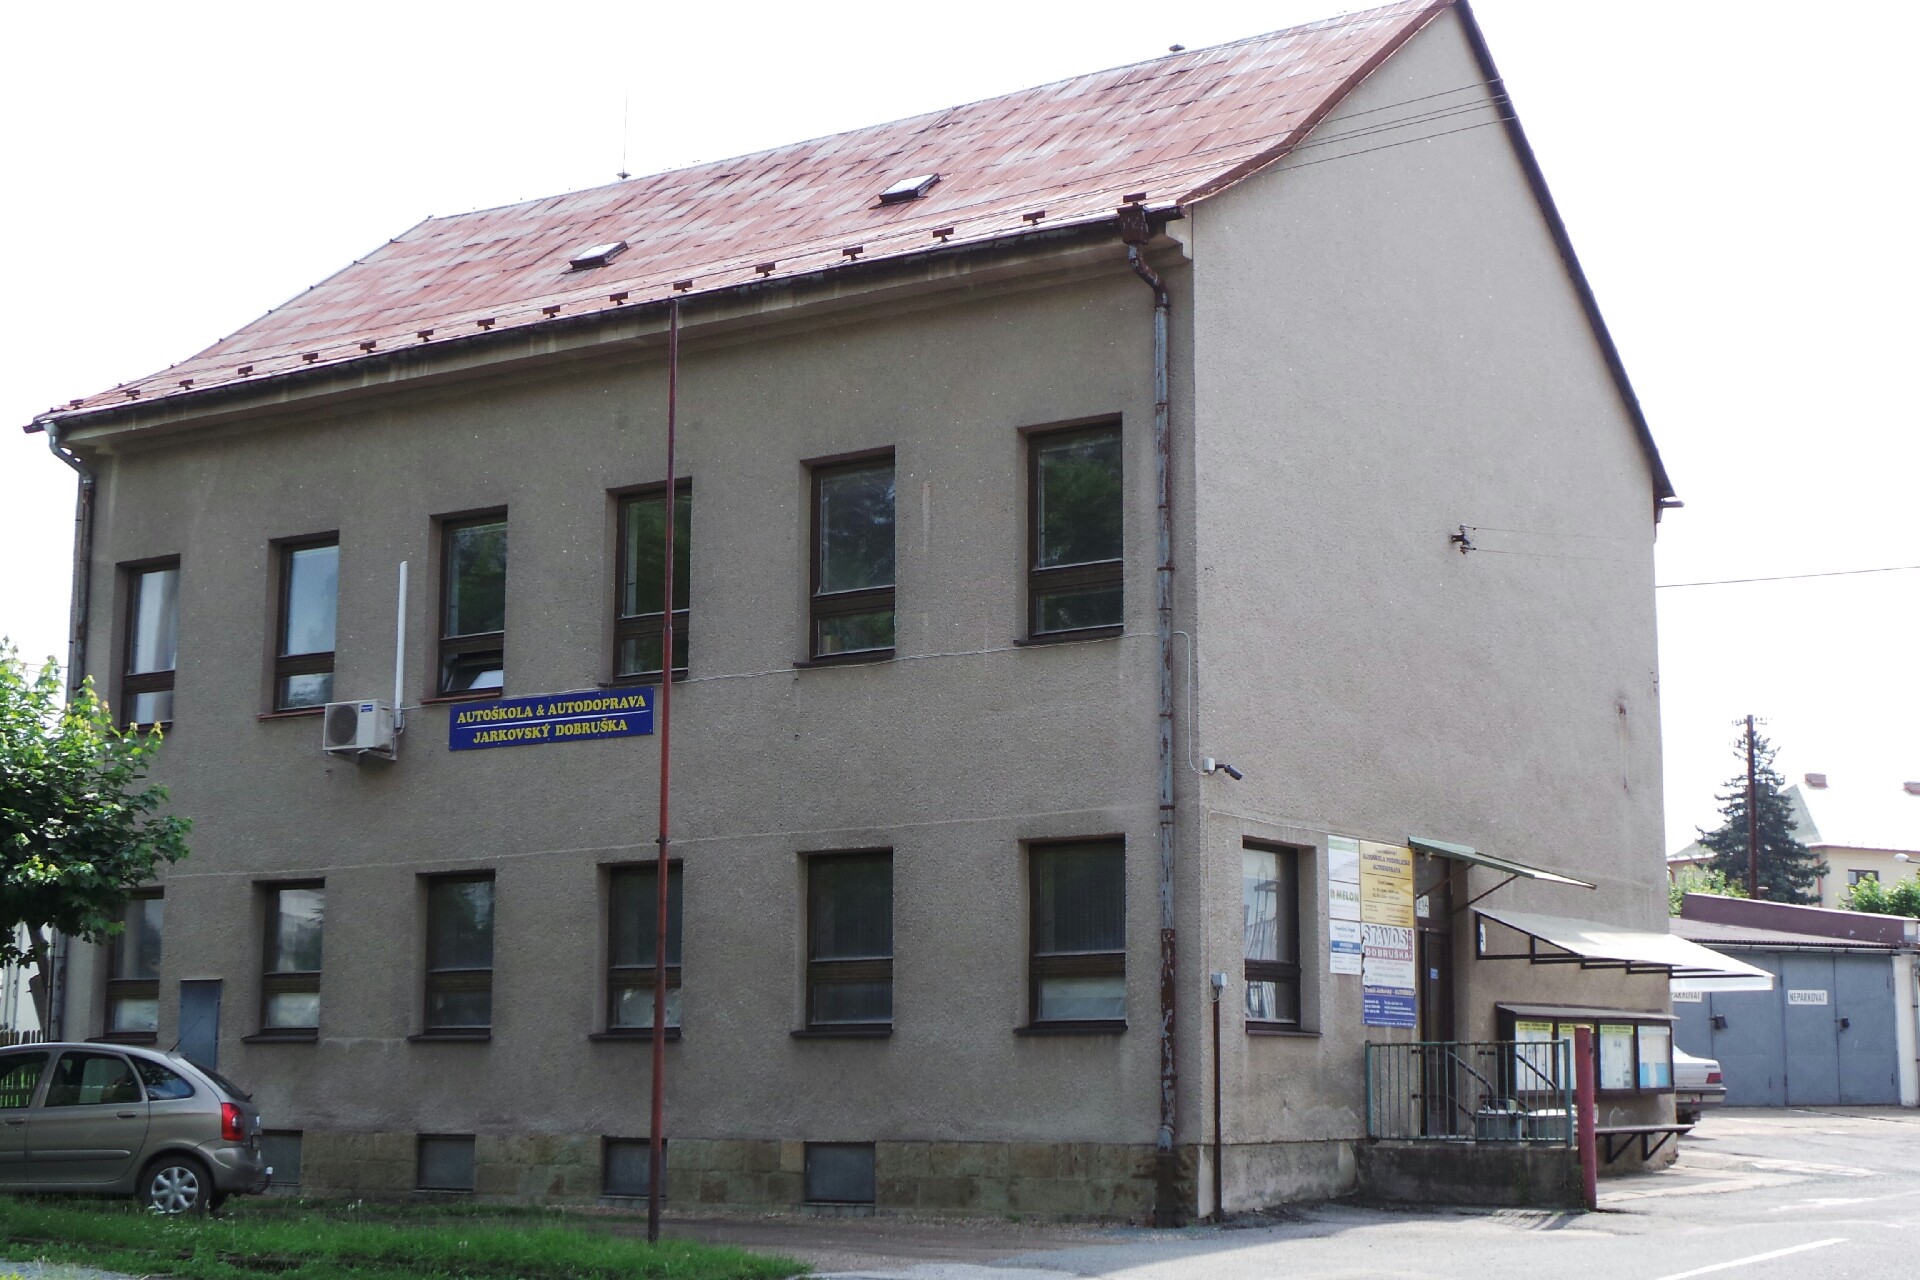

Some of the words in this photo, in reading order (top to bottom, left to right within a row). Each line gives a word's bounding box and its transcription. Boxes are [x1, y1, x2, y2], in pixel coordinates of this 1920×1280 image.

[456, 705, 533, 724] AUTOŠKOLA
[536, 704, 545, 716] &
[548, 695, 646, 715] AUTODOPRAVA
[472, 723, 550, 744] JARKOVSKÝ
[555, 718, 628, 737] DOBRUŠKA
[1336, 889, 1359, 903] MELON
[1364, 925, 1407, 947] STAVOS
[1365, 948, 1408, 959] DOBRUŠKA
[1789, 991, 1826, 1002] NEPARKOVAT
